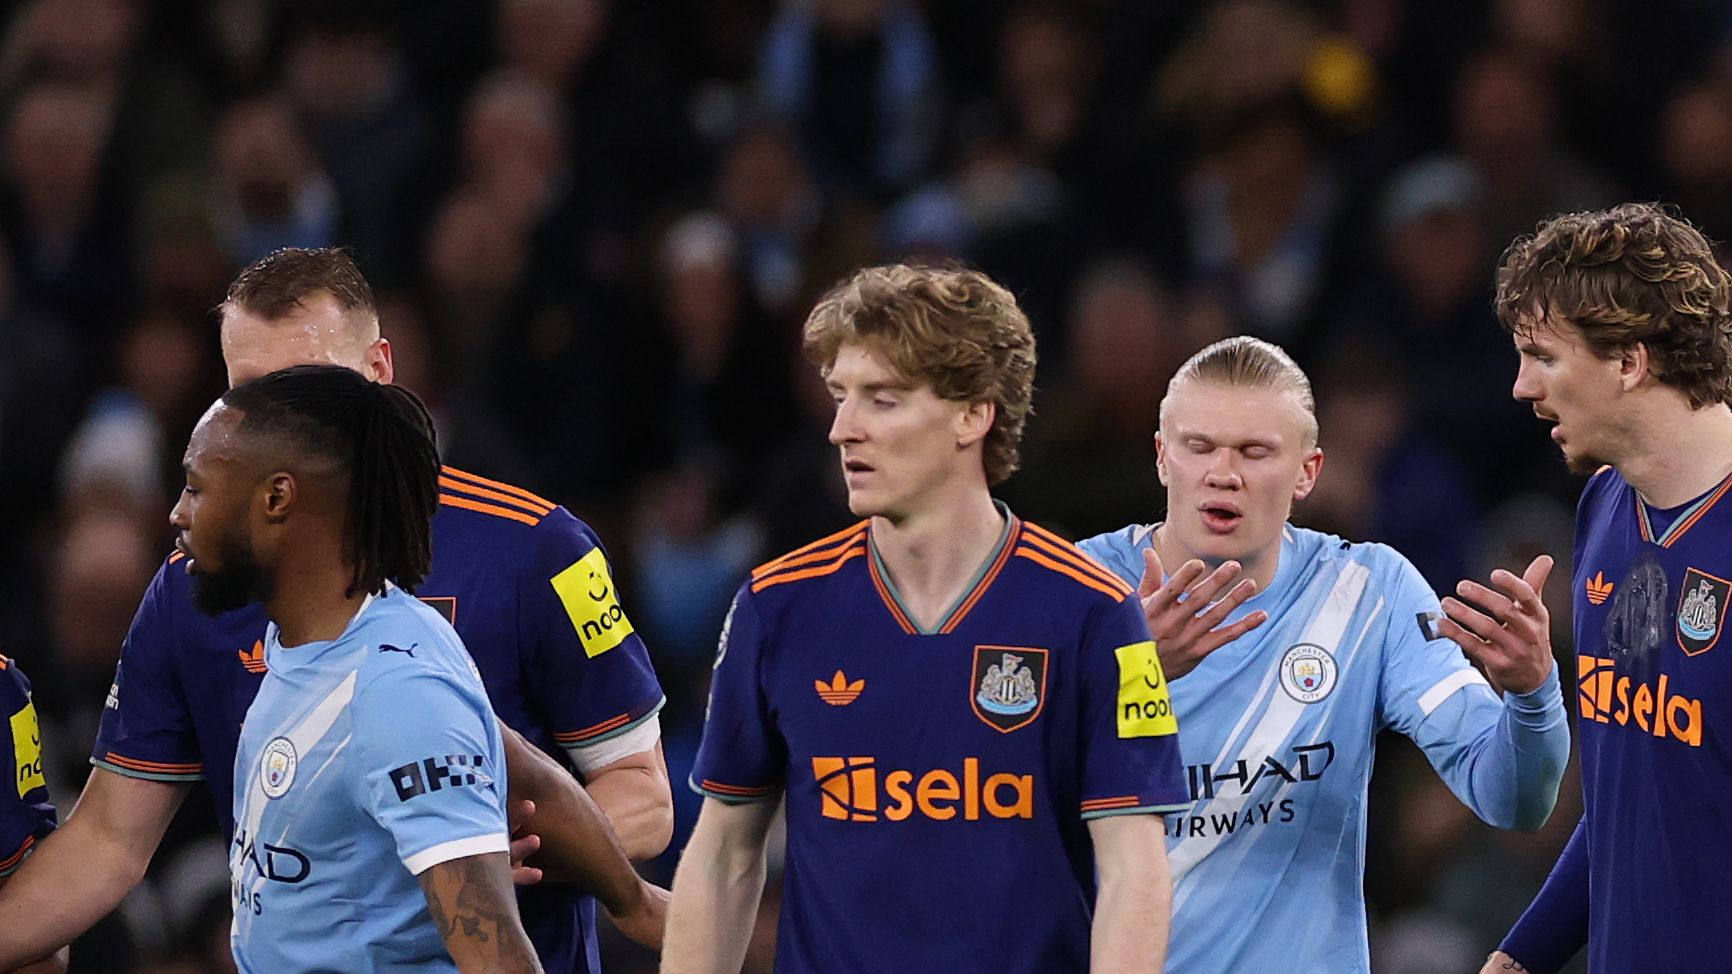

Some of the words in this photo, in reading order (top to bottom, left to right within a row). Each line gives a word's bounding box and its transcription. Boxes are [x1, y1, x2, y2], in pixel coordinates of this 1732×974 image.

[581, 604, 622, 641] noo
[1125, 697, 1173, 720] noo
[1615, 674, 1702, 747] sela
[883, 757, 1034, 821] sela
[1187, 740, 1335, 802] IHAD
[1164, 799, 1296, 838] IRWAYS
